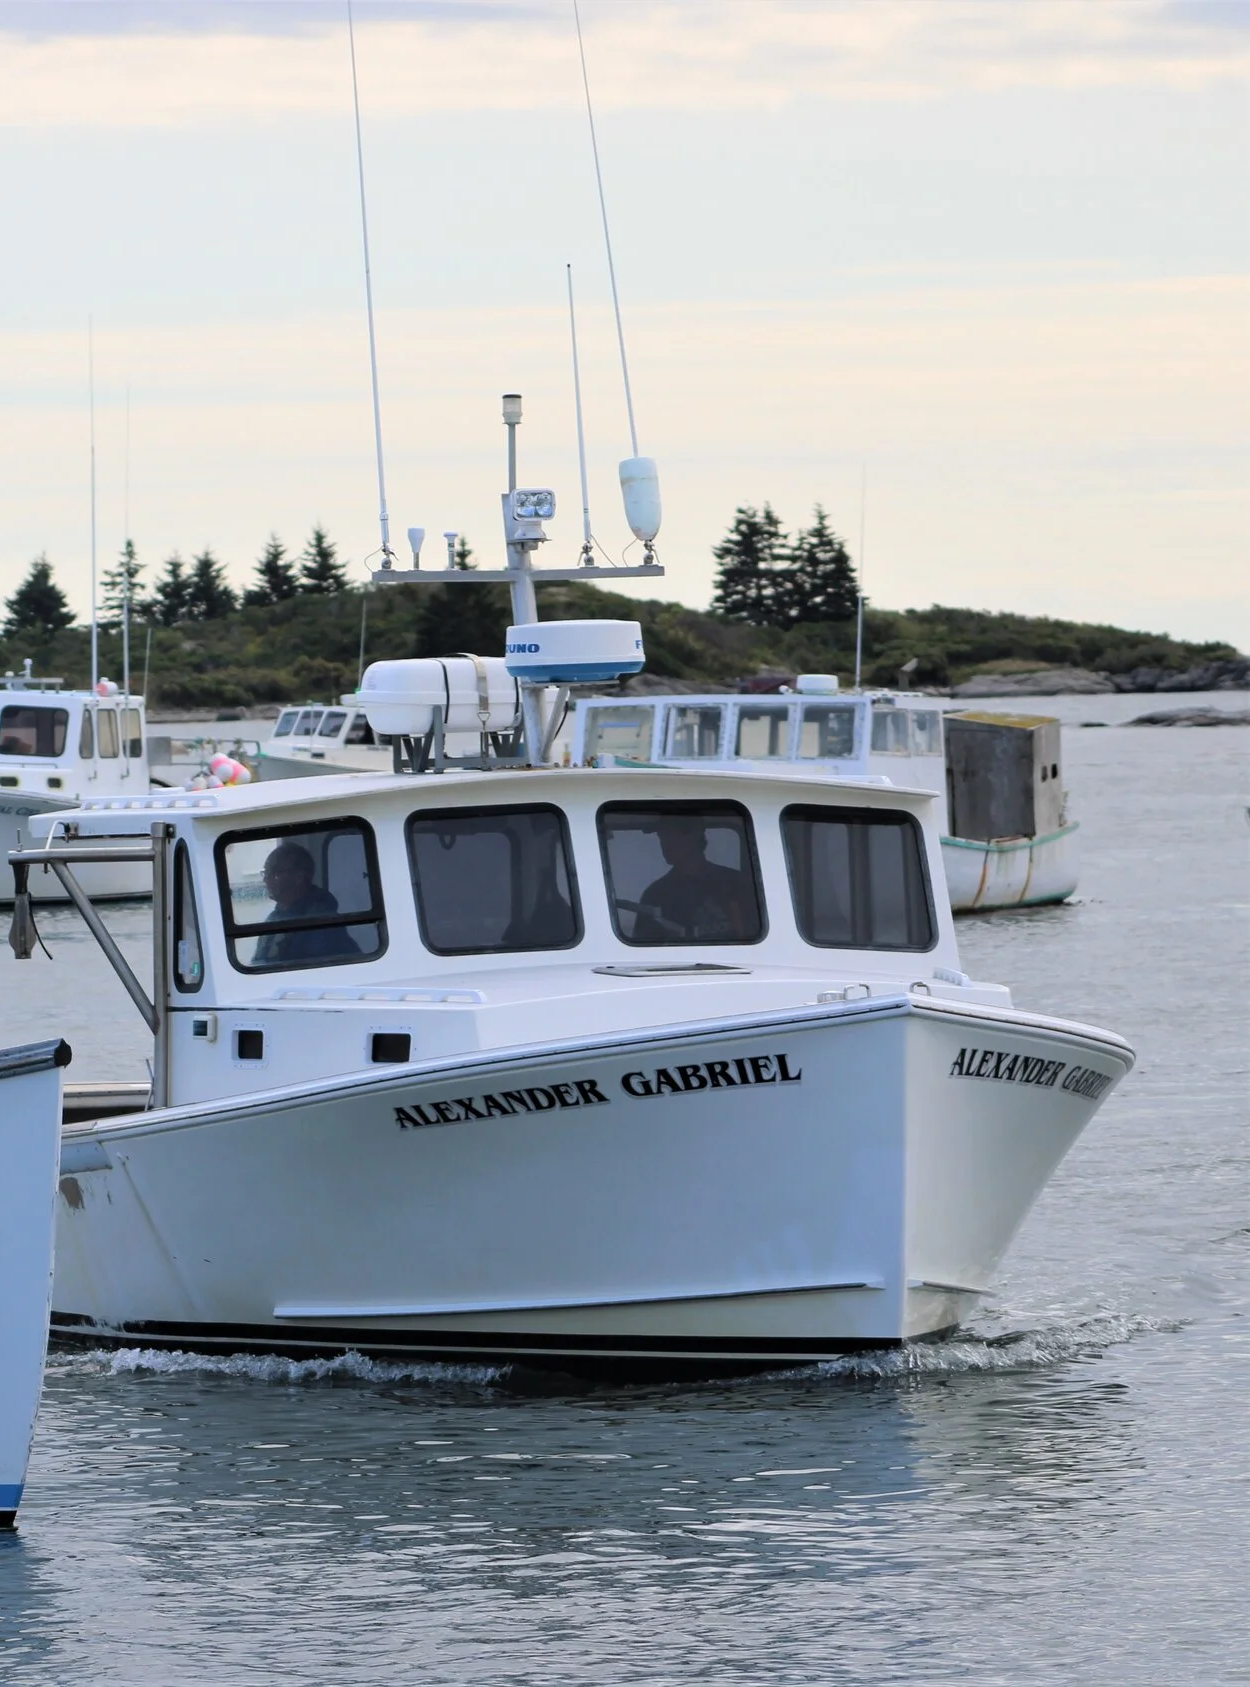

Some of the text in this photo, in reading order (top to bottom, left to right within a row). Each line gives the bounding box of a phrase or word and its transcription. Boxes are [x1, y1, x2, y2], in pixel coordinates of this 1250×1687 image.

[507, 643, 540, 653] UNO
[949, 1048, 1066, 1087] ALEXANDER
[393, 1053, 802, 1130] ALEXANDER GABRIEL
